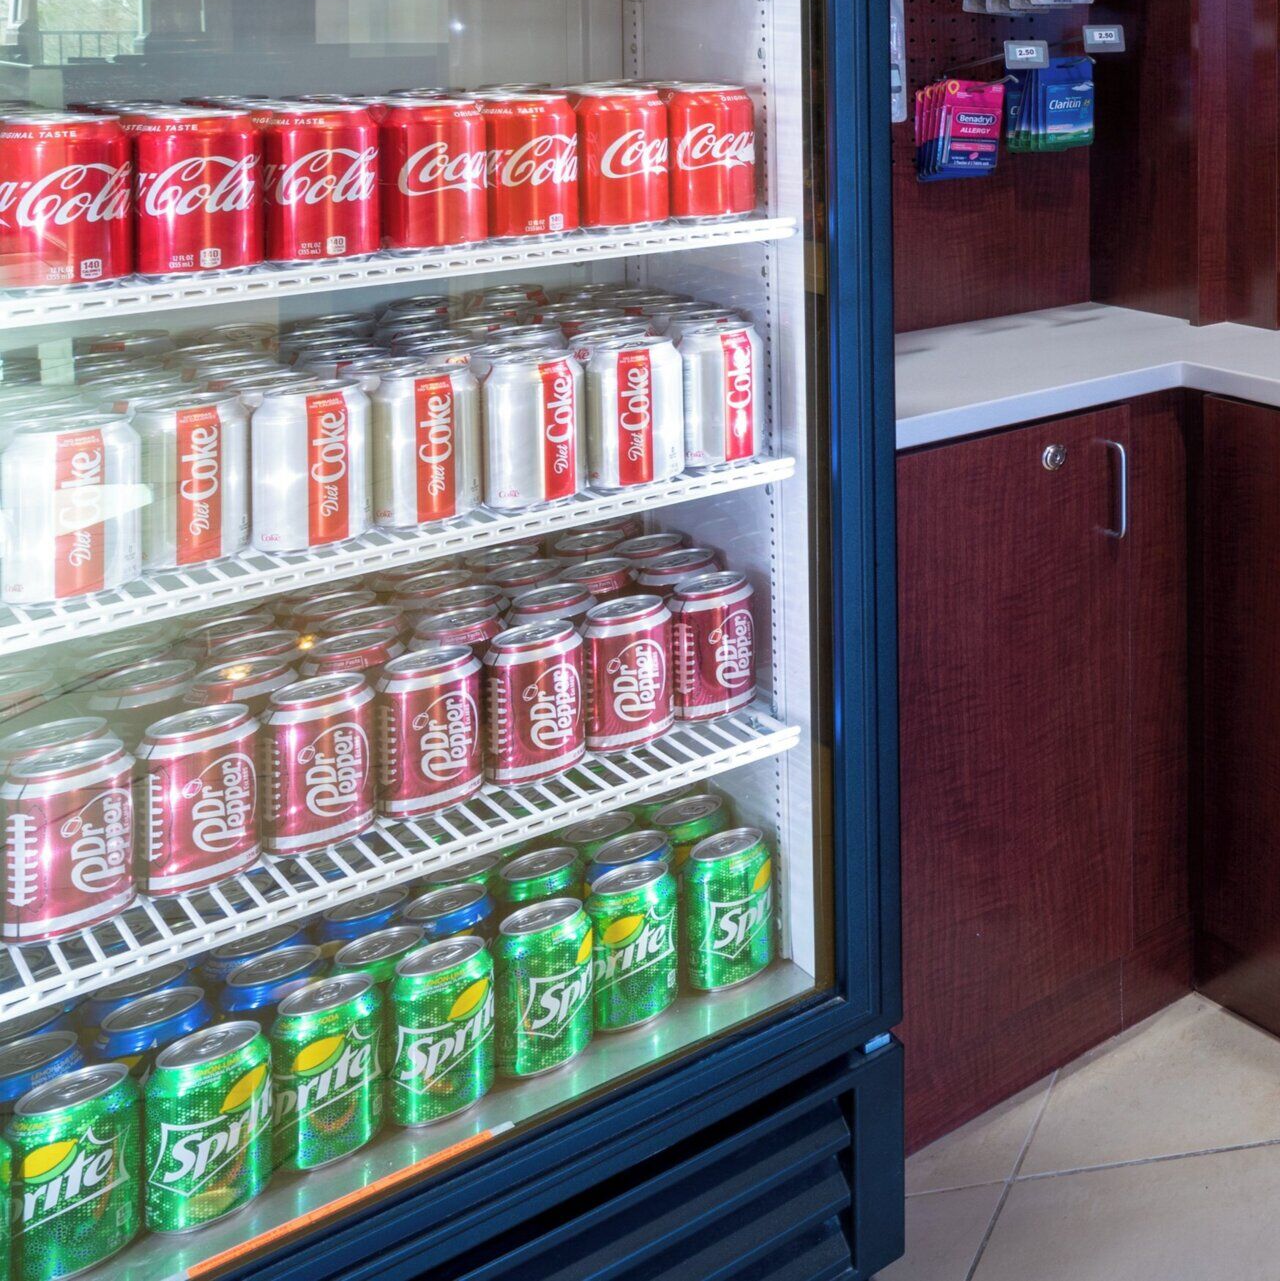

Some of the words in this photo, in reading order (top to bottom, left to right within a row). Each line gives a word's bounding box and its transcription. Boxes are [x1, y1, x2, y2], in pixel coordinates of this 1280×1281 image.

[959, 114, 994, 124] Benadryl
[1049, 99, 1081, 110] Claritin
[162, 124, 198, 132] TASTE
[546, 374, 574, 443] Coke
[620, 366, 651, 429] Coke
[554, 443, 569, 474] Diet
[628, 432, 643, 462] Diet
[530, 689, 556, 719] Dr
[530, 669, 576, 750] Pepper
[421, 719, 449, 751] Dr
[421, 697, 472, 781] Pepper
[400, 990, 494, 1081] Sprit
